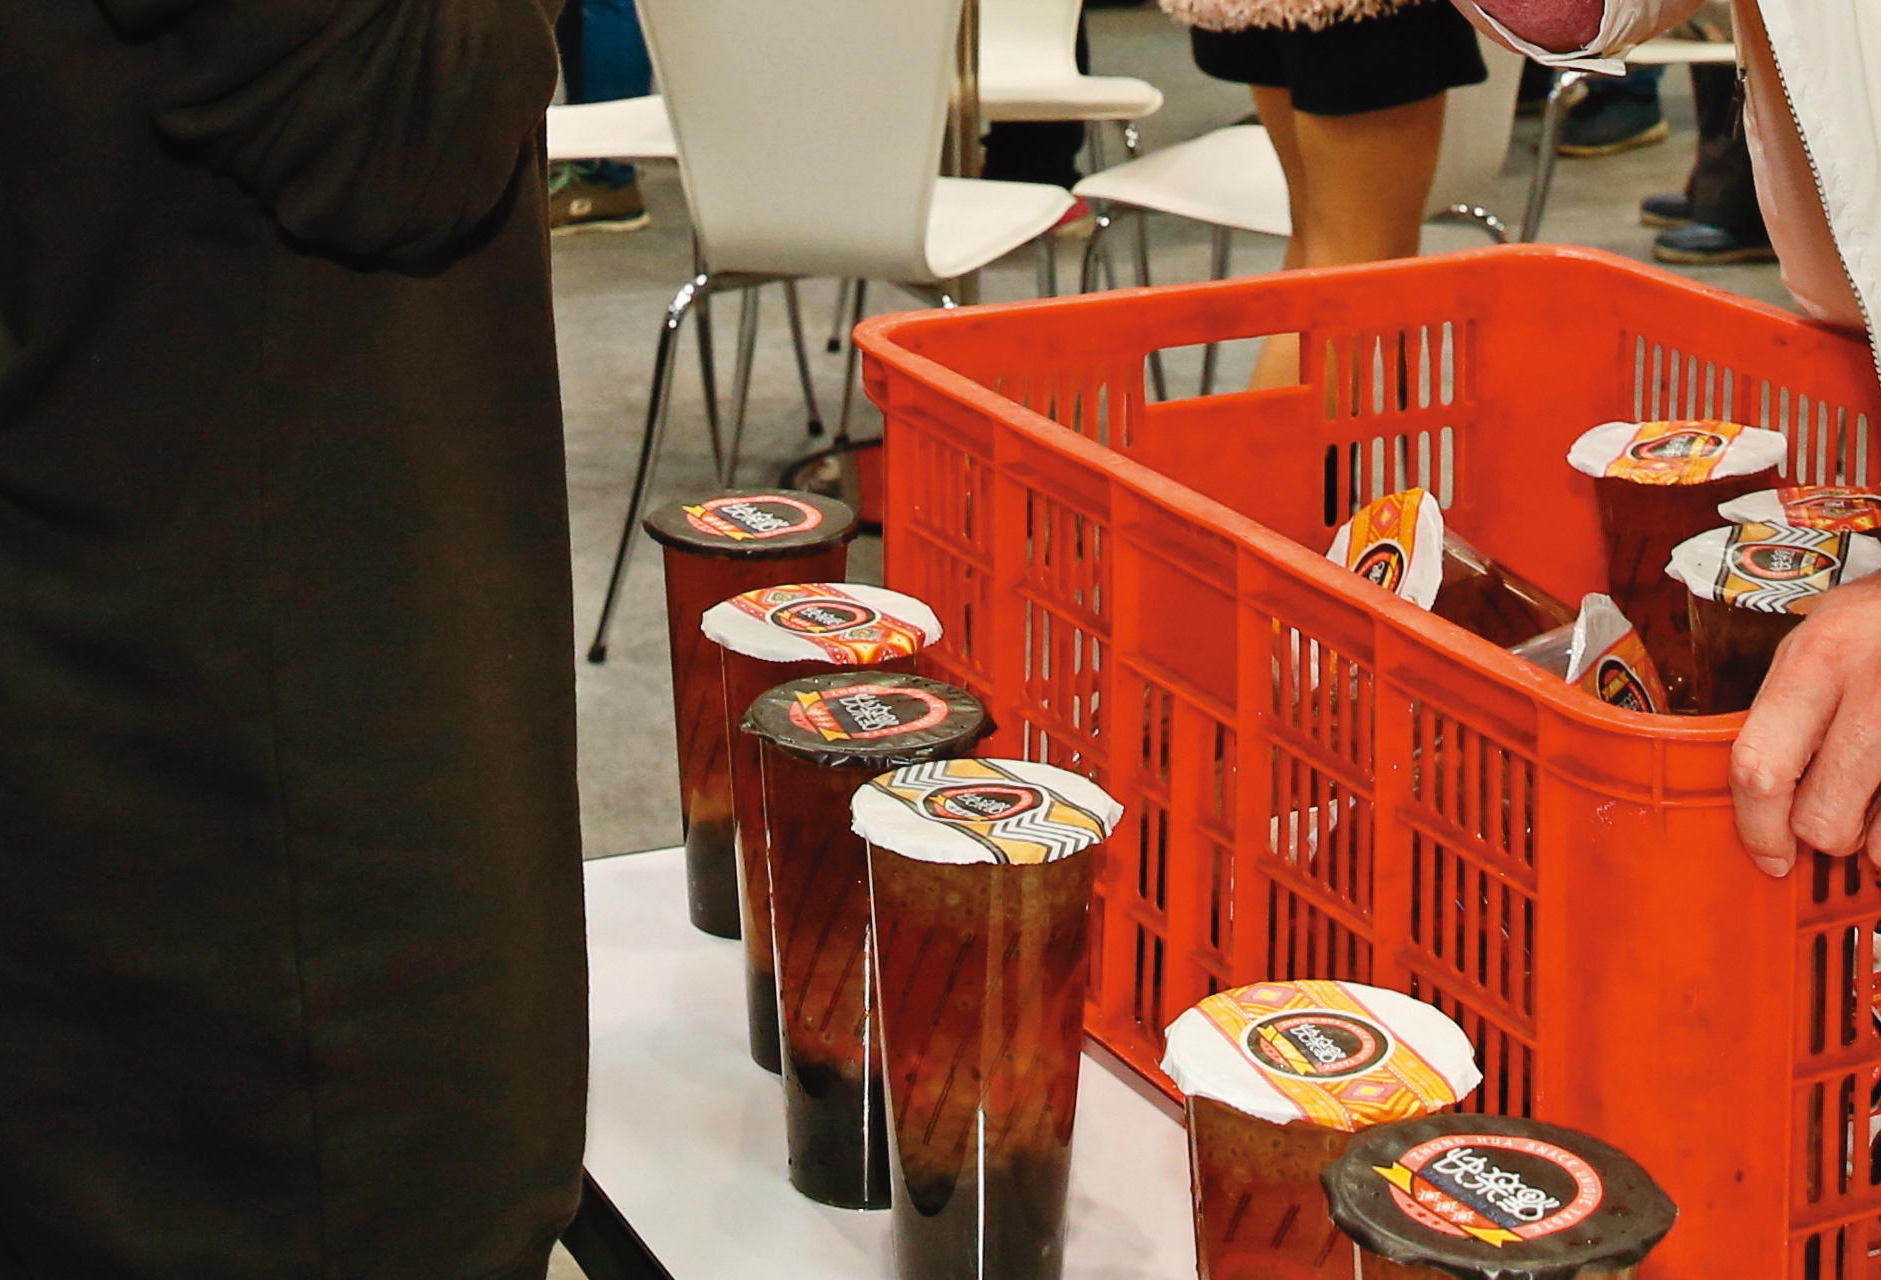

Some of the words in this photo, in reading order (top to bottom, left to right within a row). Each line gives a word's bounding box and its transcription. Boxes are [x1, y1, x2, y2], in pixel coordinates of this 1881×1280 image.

[1410, 1136, 1466, 1162] ZHONG
[1477, 1137, 1513, 1148] HUA
[1525, 1142, 1579, 1167] SNACK
[1532, 1207, 1582, 1234] TASTE
